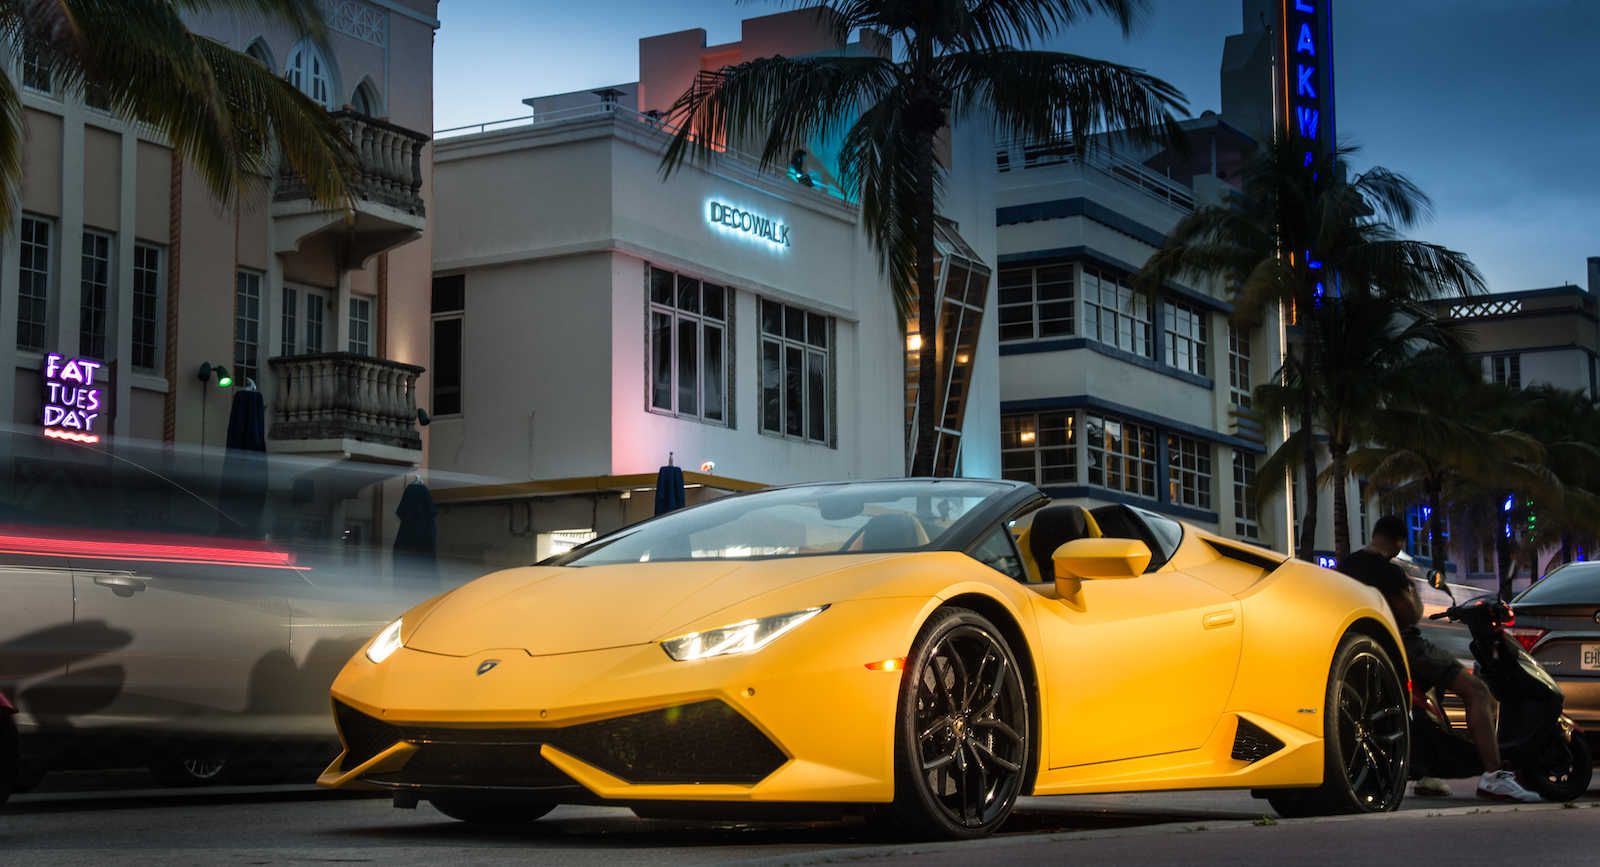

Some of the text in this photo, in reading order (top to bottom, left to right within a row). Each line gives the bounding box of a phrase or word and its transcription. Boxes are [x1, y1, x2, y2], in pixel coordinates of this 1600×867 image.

[710, 201, 790, 247] DECOWALK
[47, 354, 101, 386] FAT
[47, 382, 99, 411] TUES
[44, 405, 98, 431] DAY
